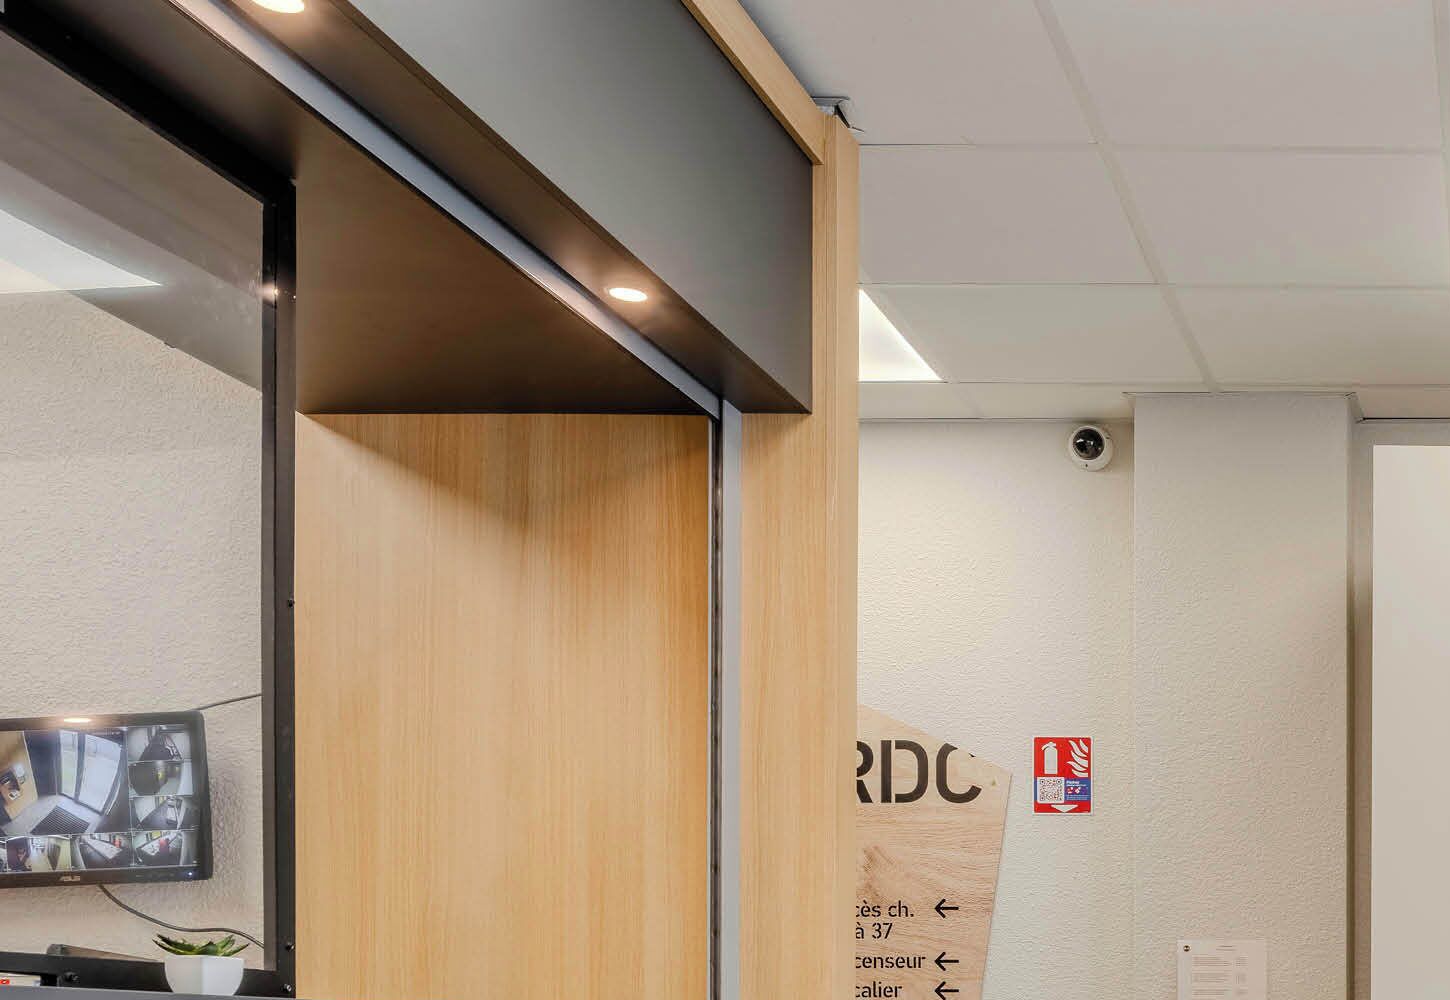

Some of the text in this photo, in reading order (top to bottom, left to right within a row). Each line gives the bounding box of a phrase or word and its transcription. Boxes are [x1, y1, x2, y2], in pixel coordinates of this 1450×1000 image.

[856, 740, 982, 804] RDC
[888, 900, 914, 918] ch.
[872, 922, 893, 939] 37
